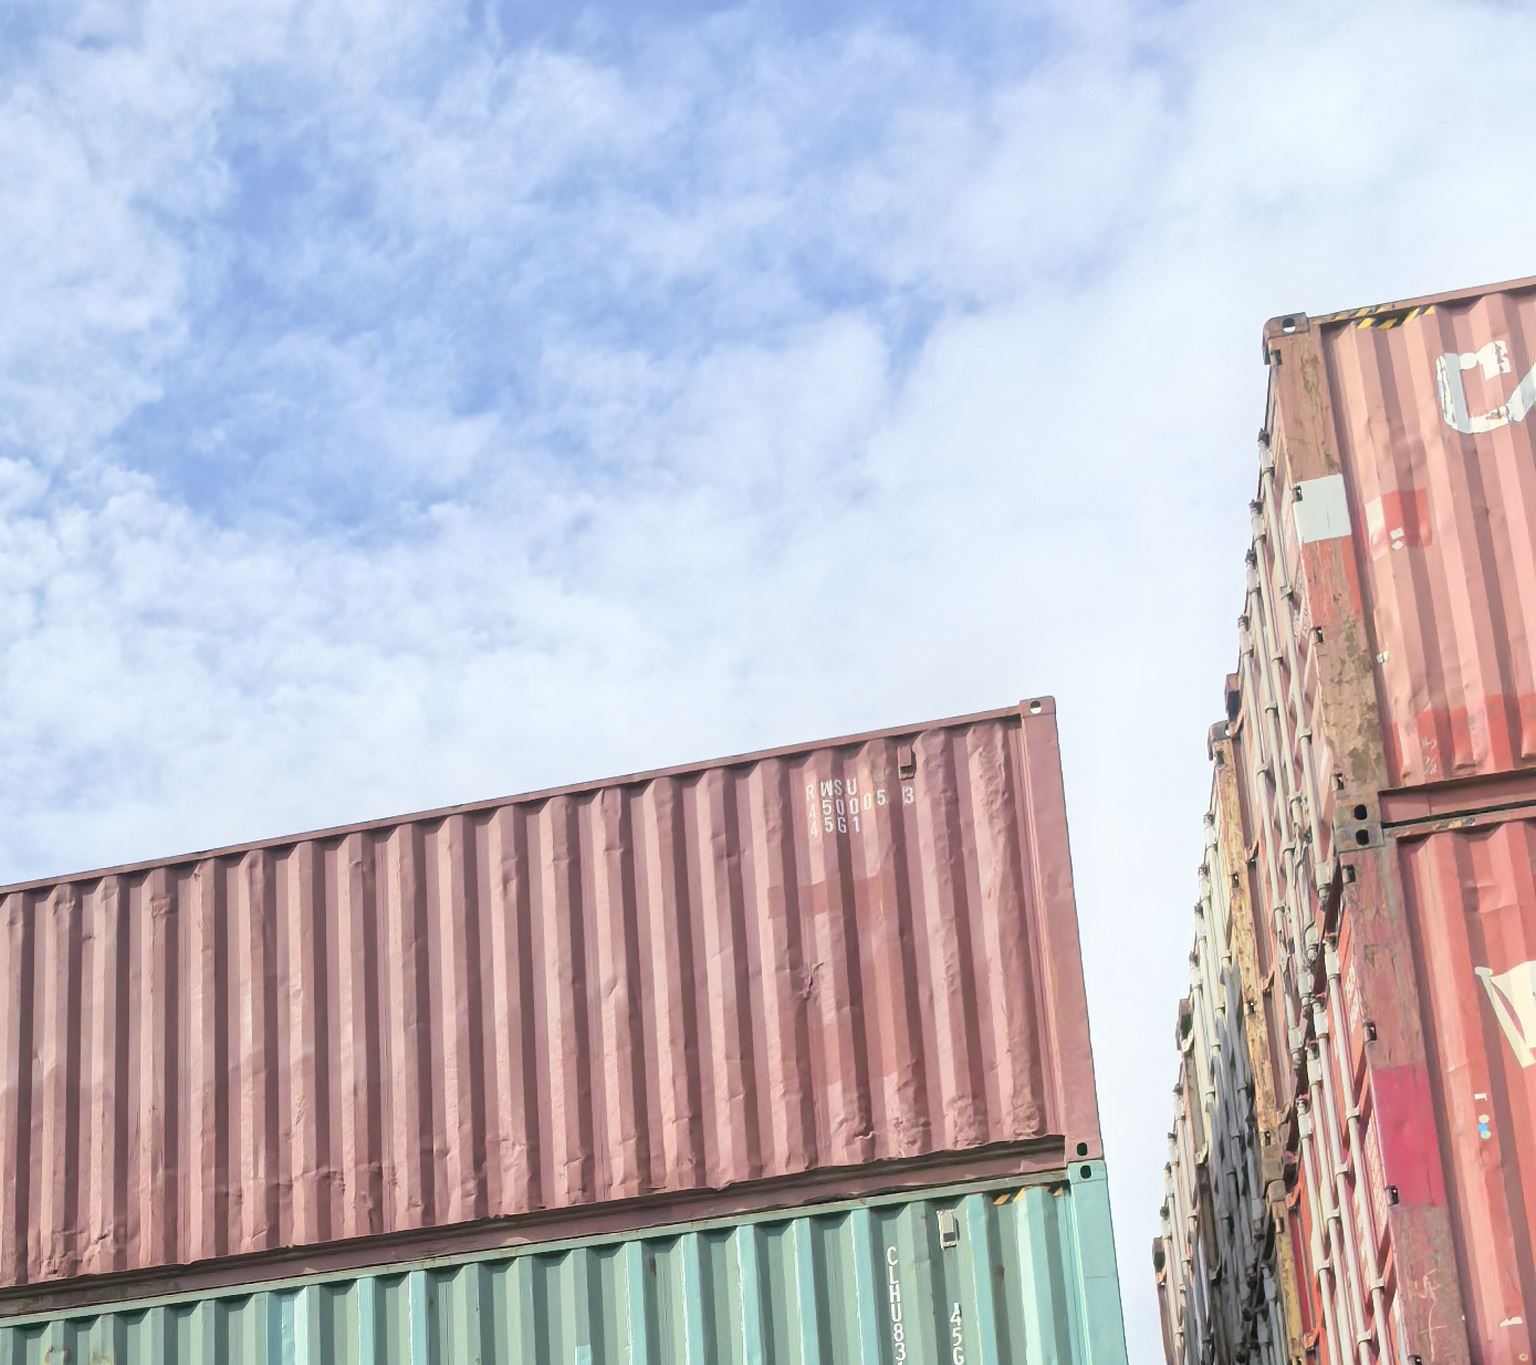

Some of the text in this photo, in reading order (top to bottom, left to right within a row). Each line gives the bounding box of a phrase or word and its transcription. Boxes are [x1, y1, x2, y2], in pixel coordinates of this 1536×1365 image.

[805, 778, 857, 800] RWSU
[808, 788, 886, 819] 450005
[810, 816, 860, 838] 45G1
